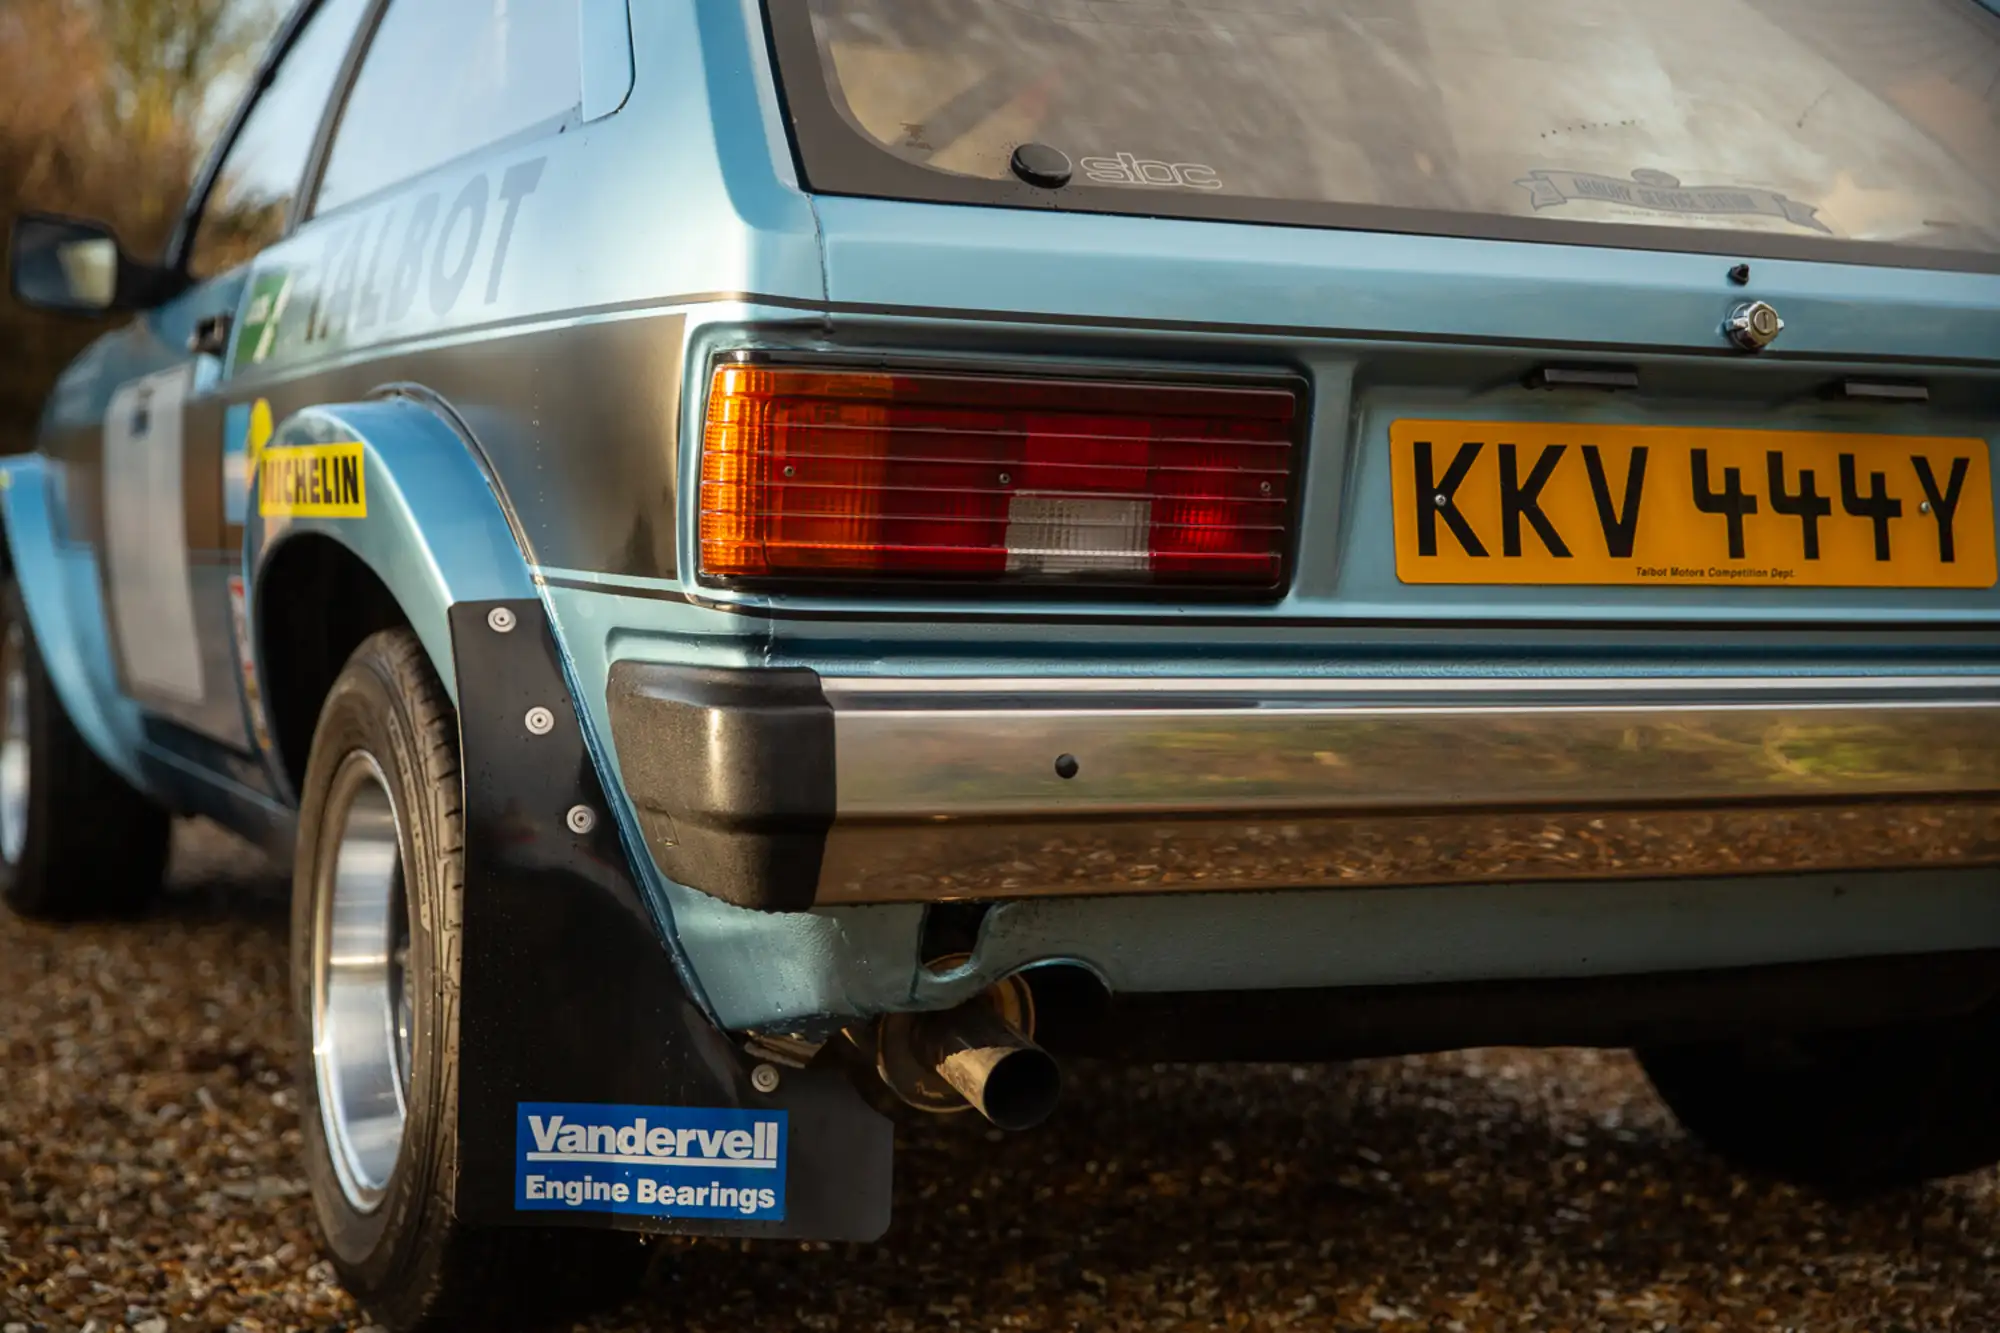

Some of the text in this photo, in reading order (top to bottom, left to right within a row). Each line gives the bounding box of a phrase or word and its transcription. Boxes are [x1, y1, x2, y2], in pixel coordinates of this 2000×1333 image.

[305, 155, 548, 343] TALBOT
[261, 454, 361, 506] MICHELIN
[1413, 441, 1971, 564] KKV 444Y
[1636, 566, 1796, 579] Talbot Motors Competition Dept.
[527, 1115, 779, 1160] Vandervell
[525, 1174, 776, 1215] Engine Bearings
